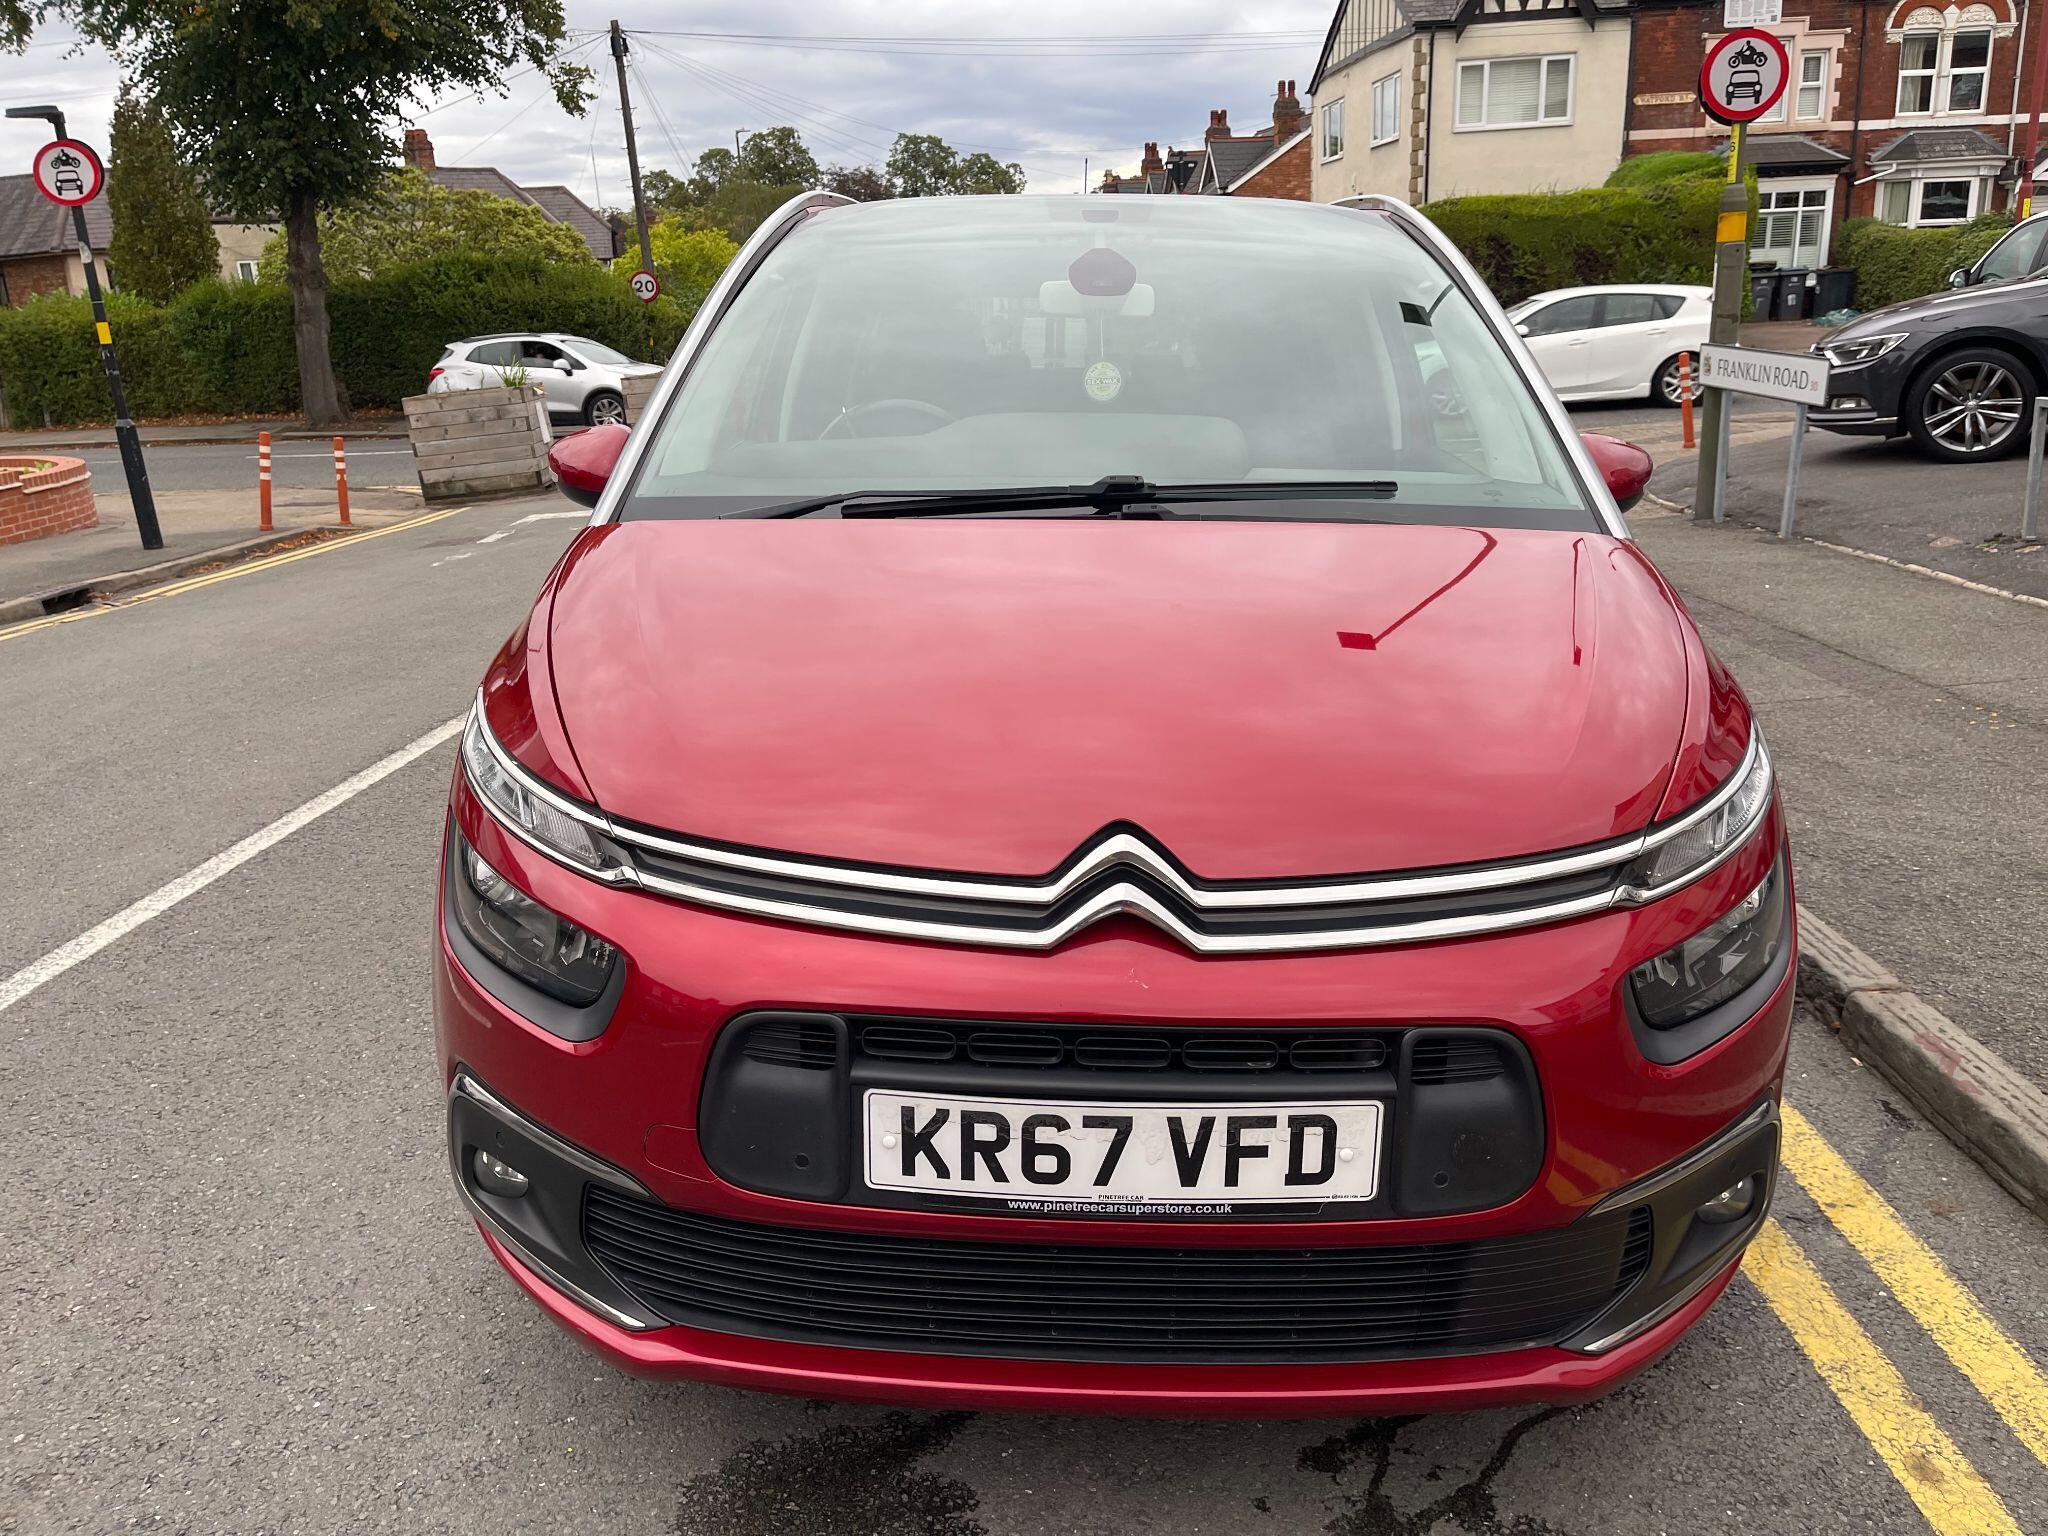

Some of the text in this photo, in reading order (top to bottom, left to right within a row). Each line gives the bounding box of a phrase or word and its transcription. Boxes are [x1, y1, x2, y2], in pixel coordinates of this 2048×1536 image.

[634, 280, 655, 293] 20
[1717, 358, 1772, 385] FRANKLIN
[1773, 366, 1809, 390] ROAD
[900, 1105, 1338, 1188] KR67 VFD
[1008, 1200, 1232, 1215] www.pinetreecarsuperstore.co.uk
